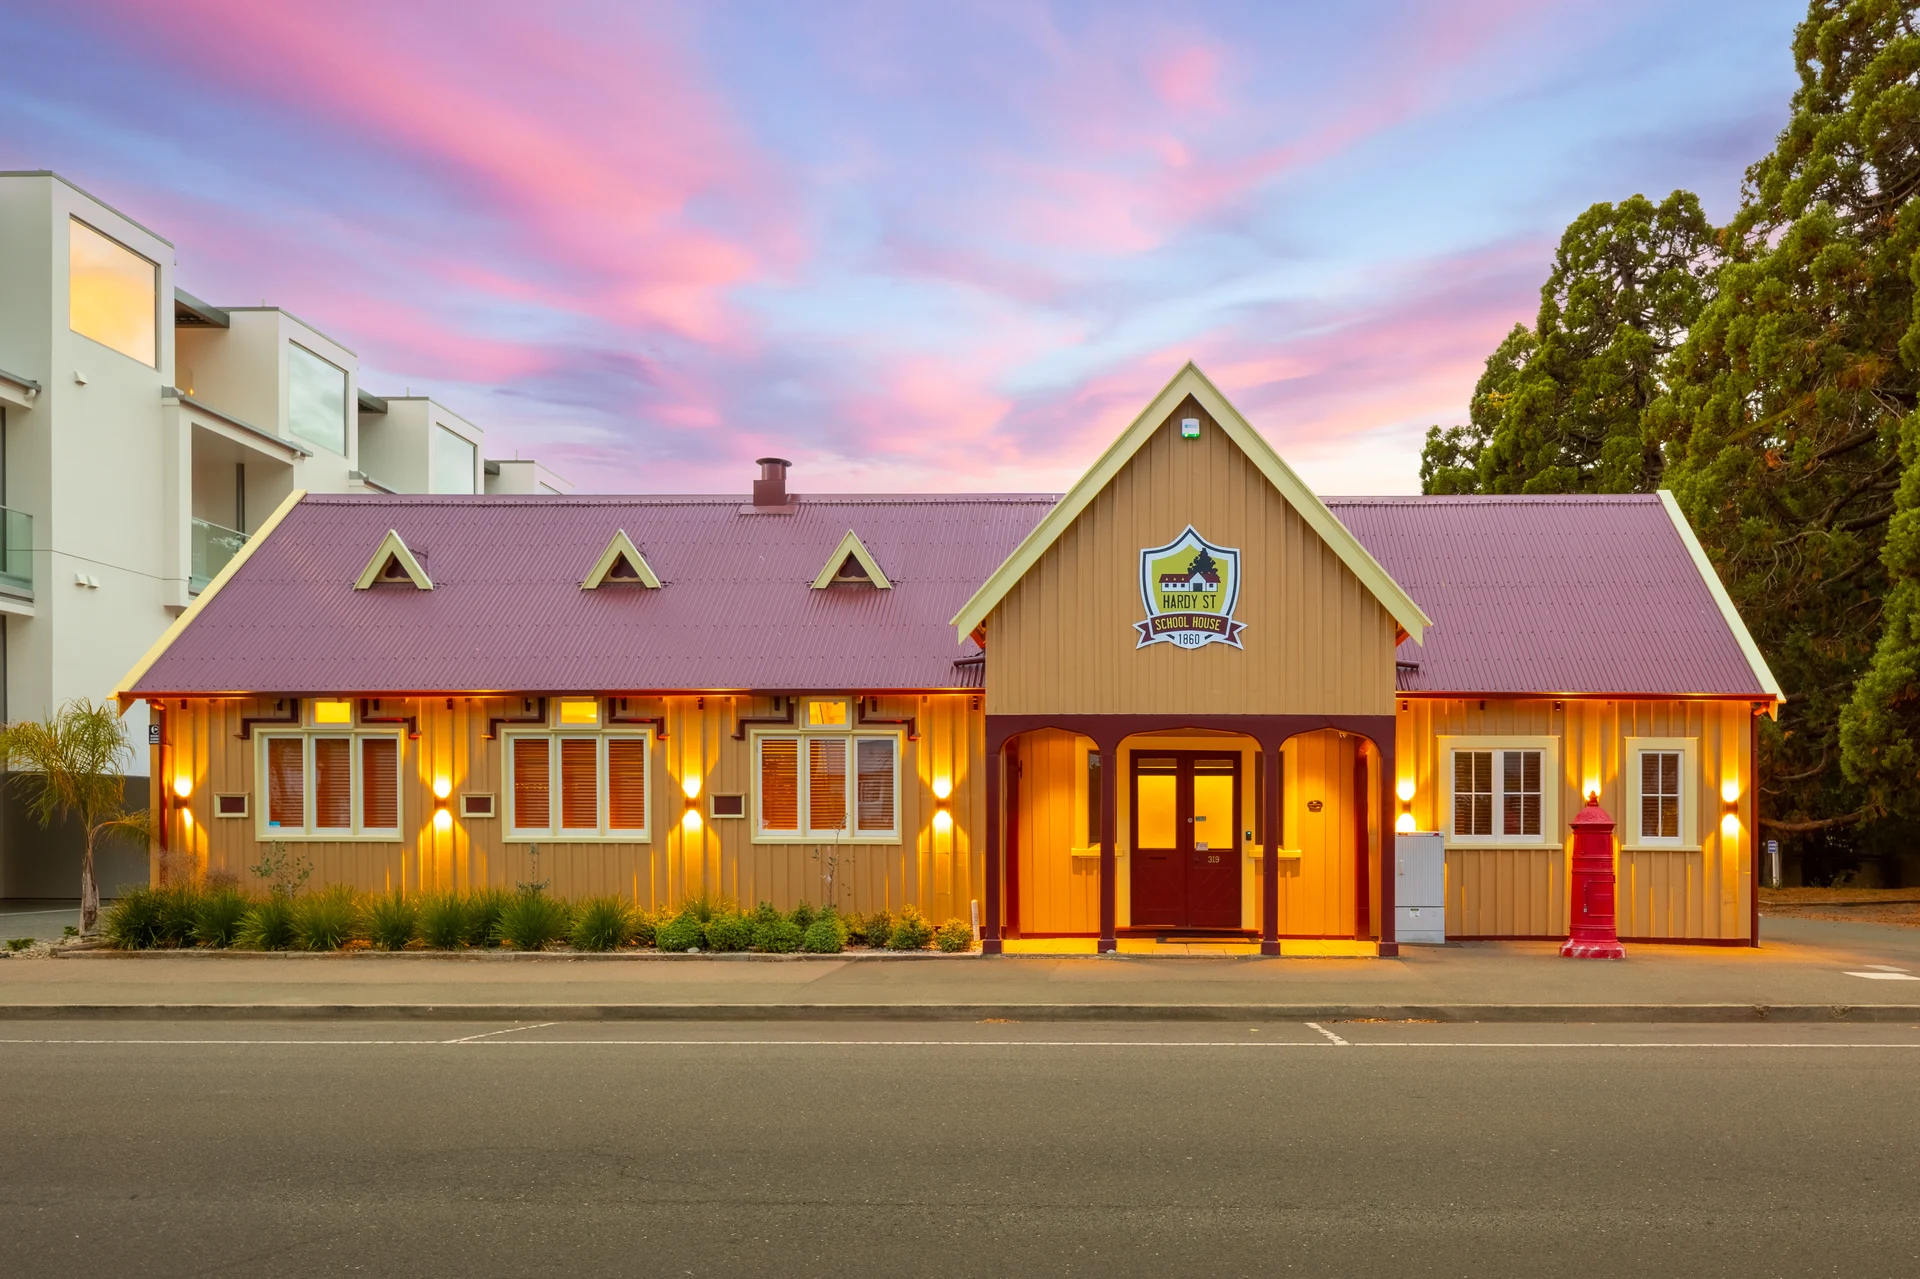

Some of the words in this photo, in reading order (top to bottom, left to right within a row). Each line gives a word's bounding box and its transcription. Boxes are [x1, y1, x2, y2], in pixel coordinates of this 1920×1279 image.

[1163, 594, 1198, 609] HARDY
[1202, 594, 1217, 609] ST
[1155, 616, 1190, 631] SCHOOL
[1192, 616, 1222, 631] HOUSE
[1178, 633, 1200, 645] 1860
[1207, 855, 1220, 864] 319
